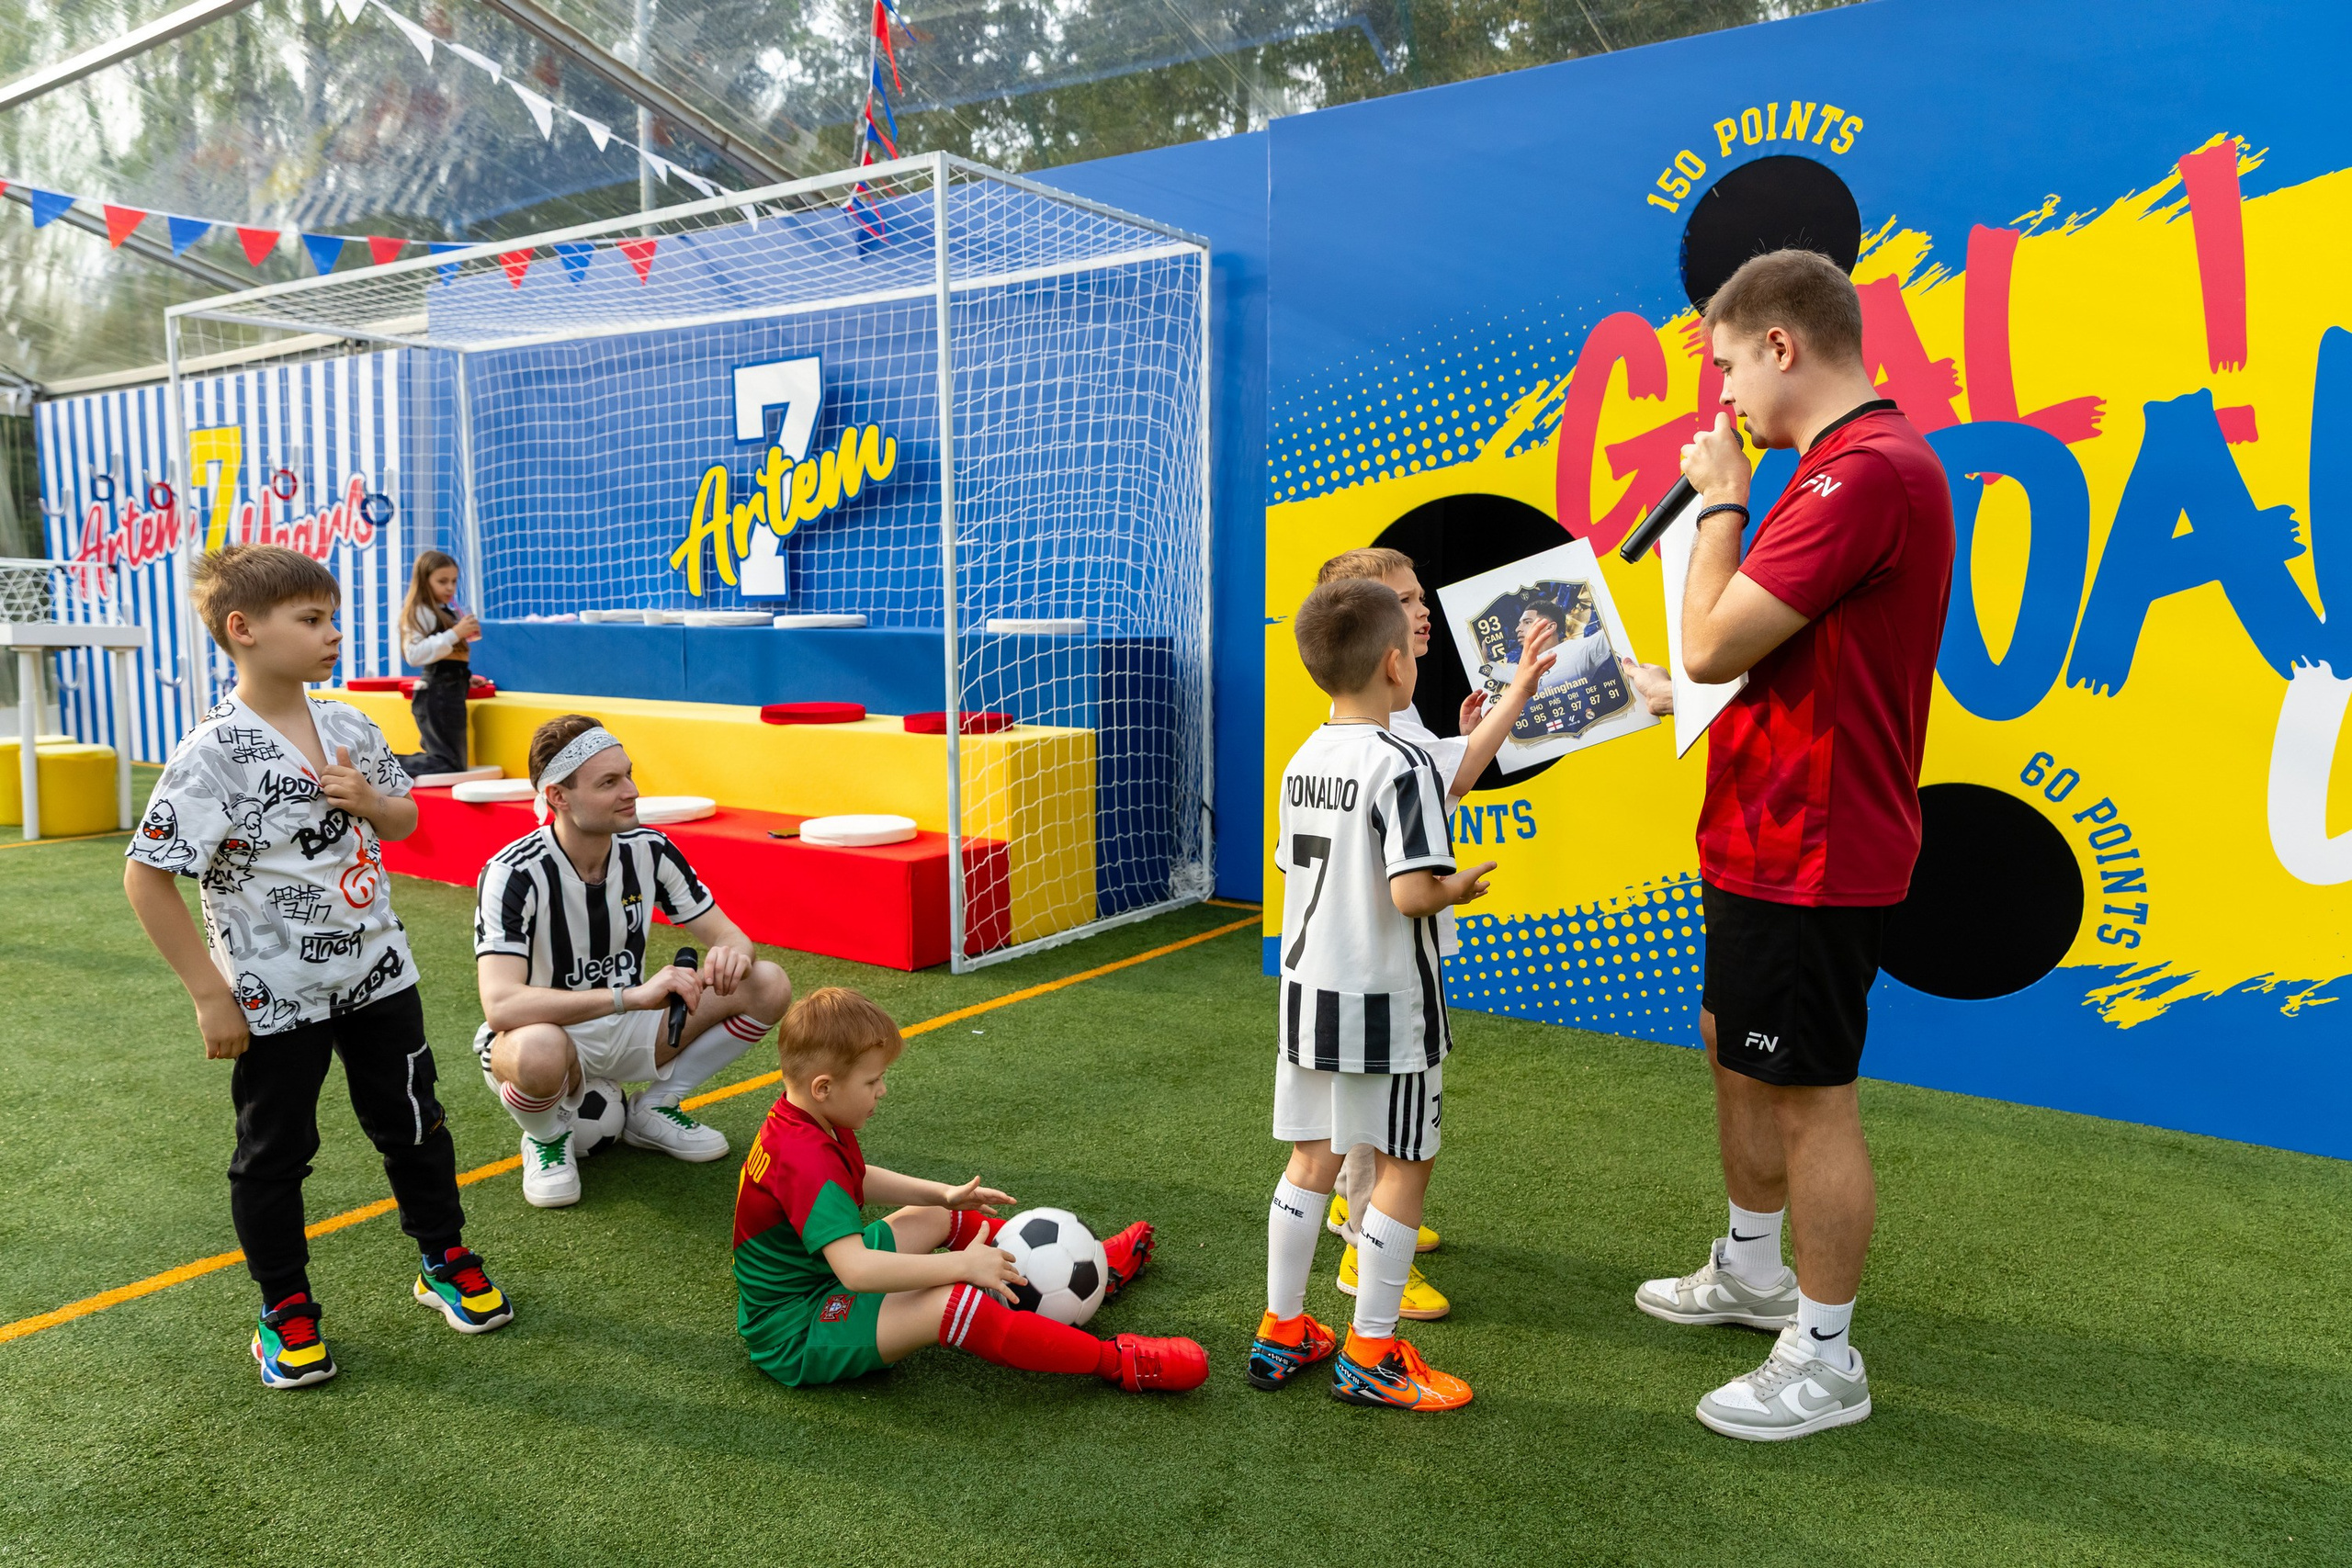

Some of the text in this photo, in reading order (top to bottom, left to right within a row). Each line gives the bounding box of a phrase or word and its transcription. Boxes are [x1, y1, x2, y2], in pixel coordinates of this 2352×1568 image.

[1646, 100, 1864, 213] 150 POINTS
[189, 425, 243, 558] 7
[734, 355, 821, 596] 7
[669, 424, 897, 597] Artem
[1477, 615, 1501, 635] 93
[1484, 631, 1504, 644] CAM
[1515, 718, 1529, 729] 90
[1533, 713, 1547, 724] 95
[1552, 706, 1566, 717] 92
[1571, 700, 1582, 712] 97
[1589, 694, 1600, 705] 87
[1608, 689, 1620, 699] 91
[1530, 679, 1617, 713] SHO PAS DRI DEF PHY
[1532, 677, 1589, 701] Bellingham
[1449, 799, 1537, 845] INTS
[2019, 751, 2149, 950] 60 POINTS
[1285, 833, 1332, 970] 7
[1272, 1196, 1305, 1218] ELME
